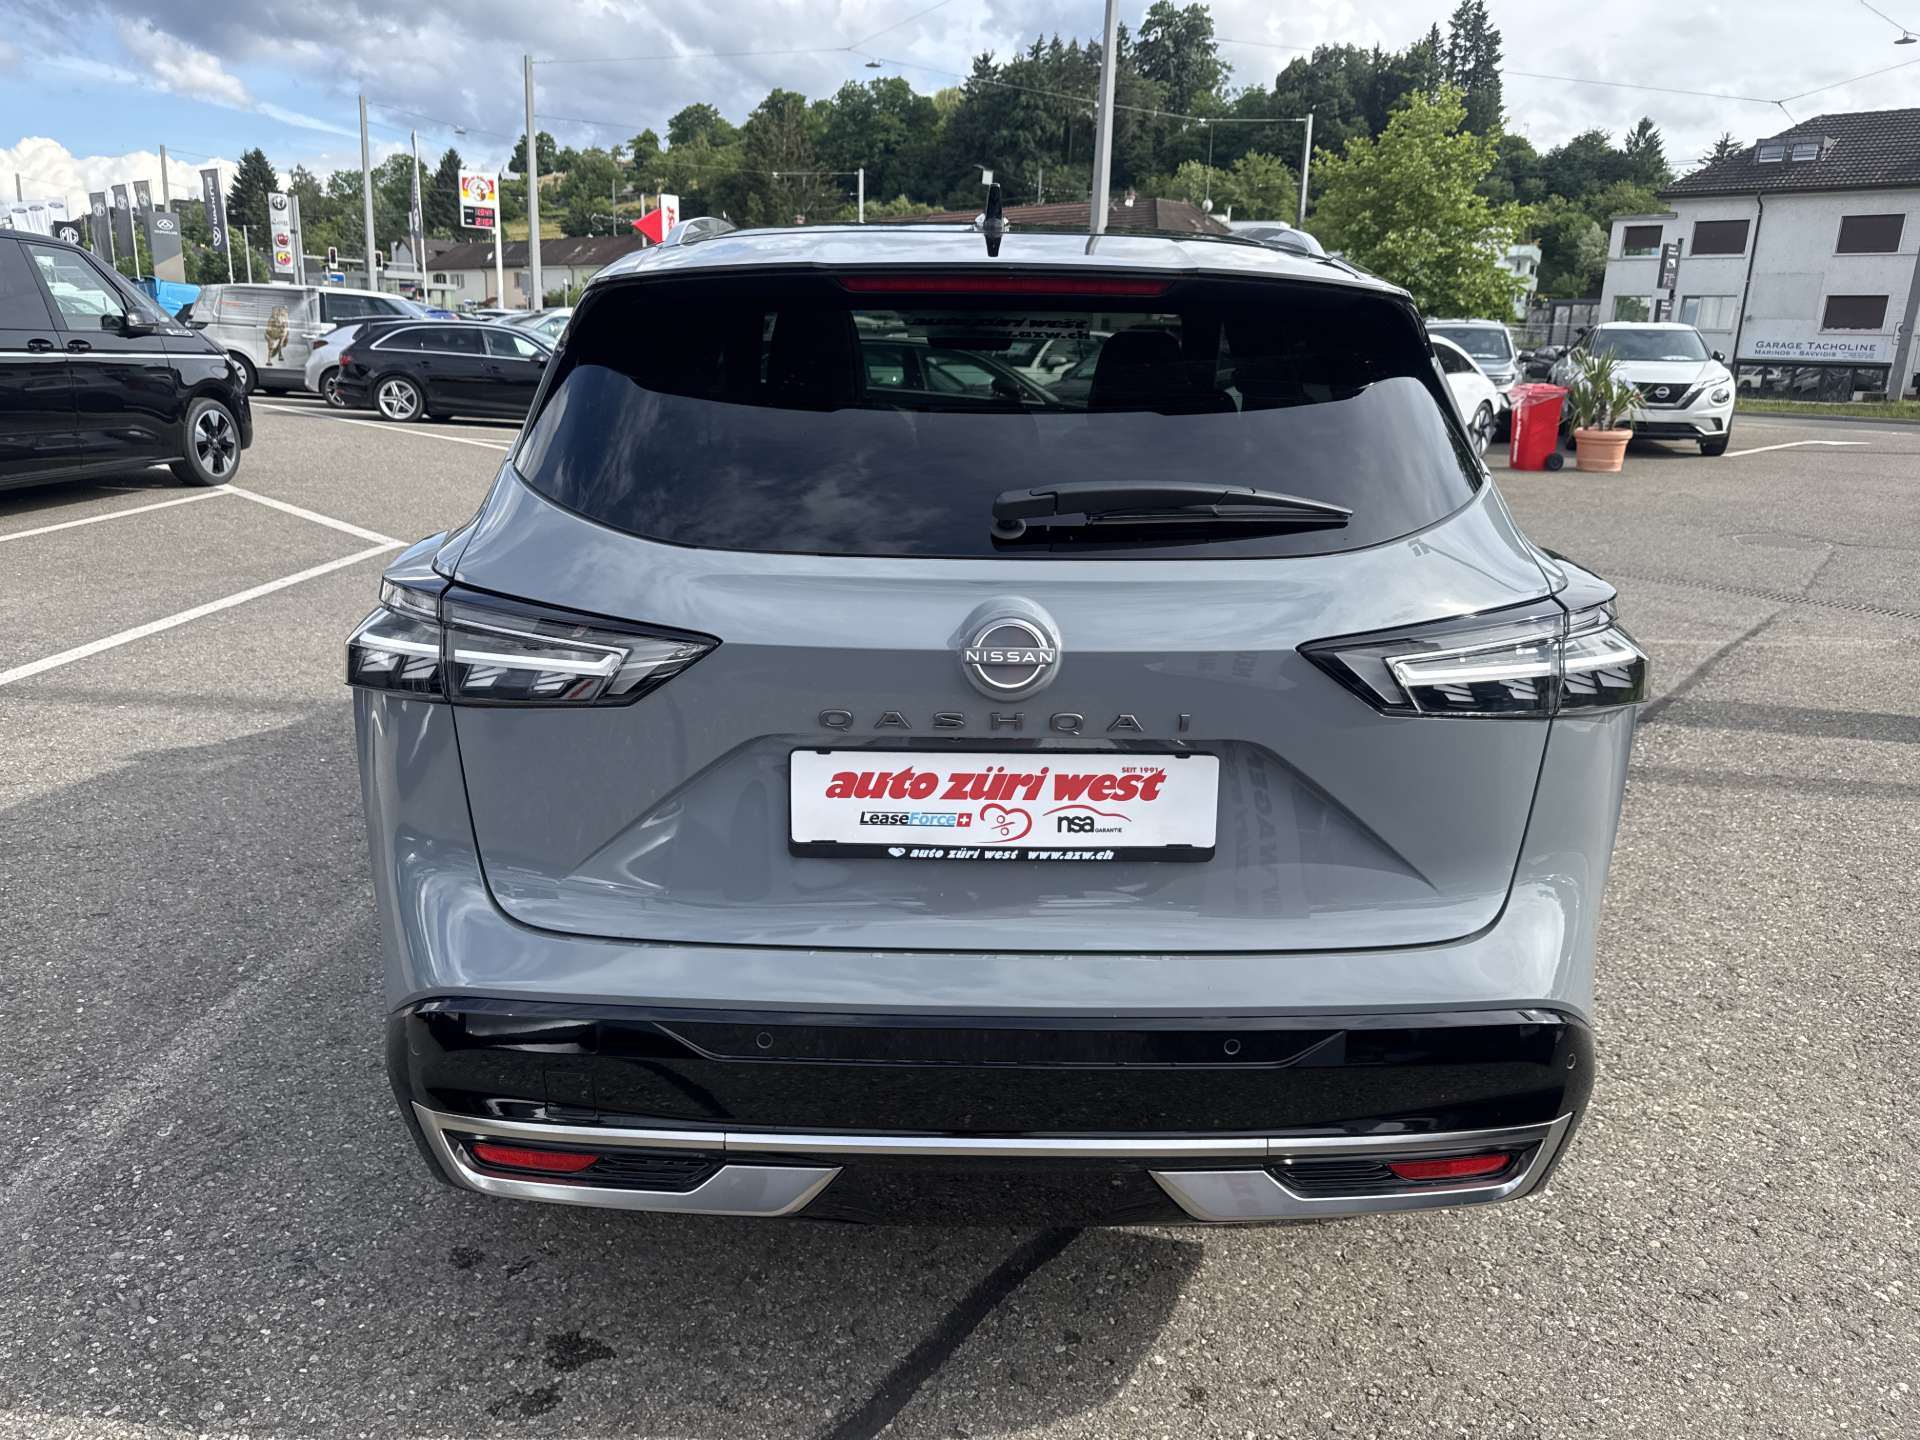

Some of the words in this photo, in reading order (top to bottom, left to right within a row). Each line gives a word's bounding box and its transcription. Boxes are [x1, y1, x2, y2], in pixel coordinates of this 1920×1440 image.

[1755, 341, 1803, 350] GARAGE
[1807, 341, 1877, 352] TACHOLINE
[966, 650, 1053, 662] NISSAN
[818, 710, 1192, 735] QASHQAI
[825, 765, 939, 800] auto
[939, 766, 1050, 801] züri
[1053, 767, 1168, 802] west
[859, 811, 956, 827] LeaseForce
[1057, 815, 1095, 833] nsa
[909, 848, 944, 859] auto
[947, 847, 980, 859] züri
[983, 849, 1019, 860] west
[1027, 849, 1115, 861] www.azw.ch
